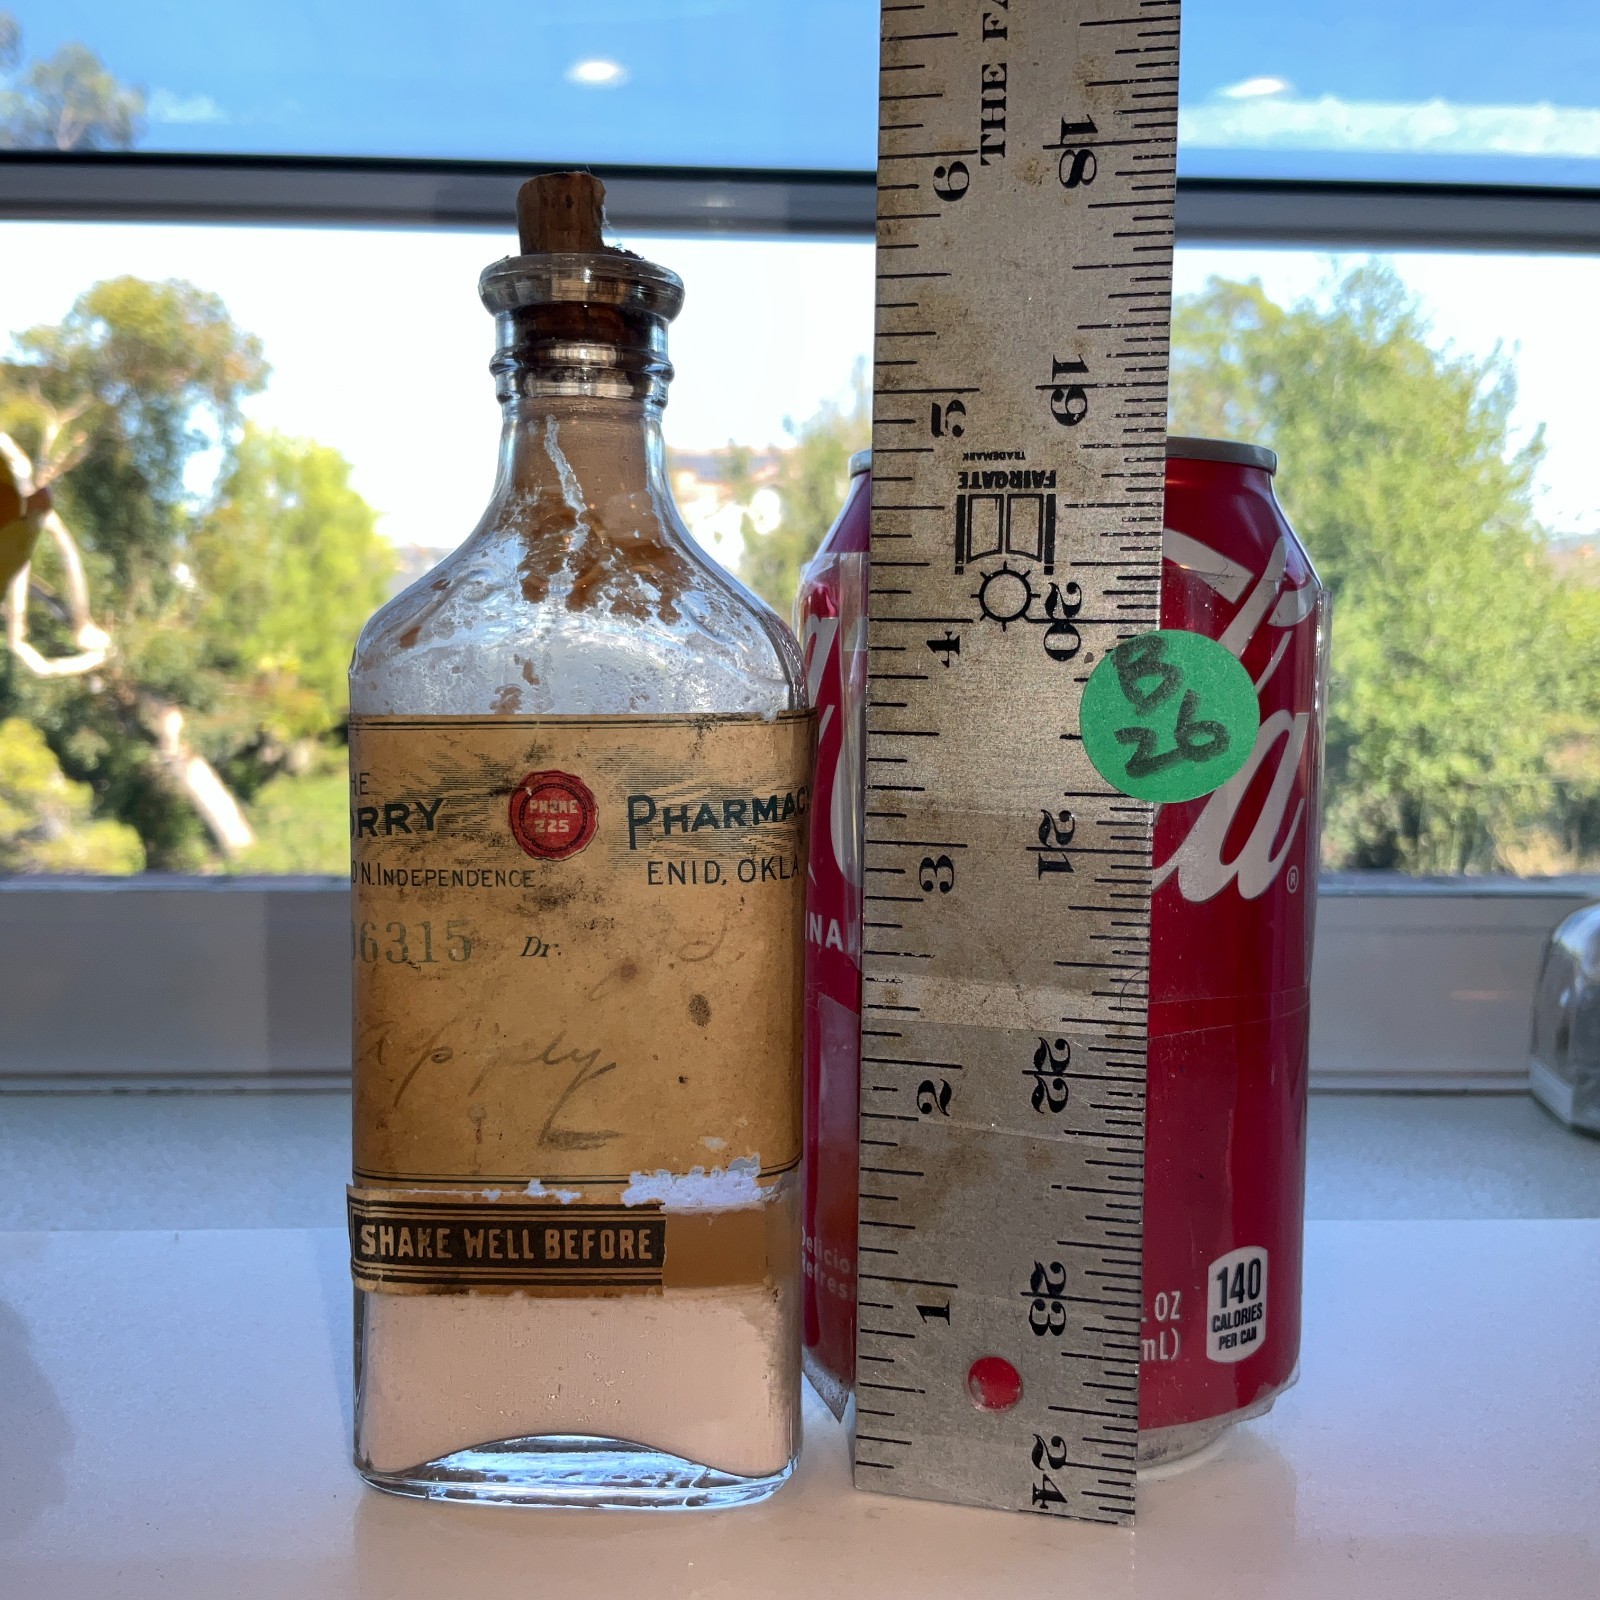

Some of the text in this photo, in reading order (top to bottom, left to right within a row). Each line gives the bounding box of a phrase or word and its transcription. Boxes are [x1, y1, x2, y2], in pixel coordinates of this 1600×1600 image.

[981, 0, 1009, 166] THE F
[1058, 114, 1098, 188] 18
[933, 161, 970, 202] 6
[1050, 354, 1089, 426] 19
[931, 400, 967, 437] 5
[962, 451, 1026, 462] TRADEMARK
[957, 470, 1057, 489] FAIRGATE
[1043, 582, 1082, 662] 20
[926, 631, 961, 668] 4
[1110, 633, 1185, 717] B
[1113, 688, 1231, 779] 26
[351, 785, 809, 851] RRY PHARMAC
[529, 799, 579, 814] PHONE
[1037, 809, 1076, 880] 21
[647, 860, 728, 886] ENID,
[918, 854, 955, 894] 3
[351, 919, 562, 964] 6315 Dr.
[1030, 1037, 1071, 1114] 22
[916, 1079, 952, 1116] 2
[361, 1224, 653, 1260] SHAKE WELL BEFORE
[1028, 1260, 1067, 1337] 23
[1216, 1256, 1262, 1309] 140
[915, 1300, 951, 1326] 1
[1154, 1290, 1182, 1322] OZ
[1212, 1302, 1263, 1334] CALORIES
[1218, 1326, 1257, 1351] PER CAN
[1030, 1433, 1068, 1511] 24
